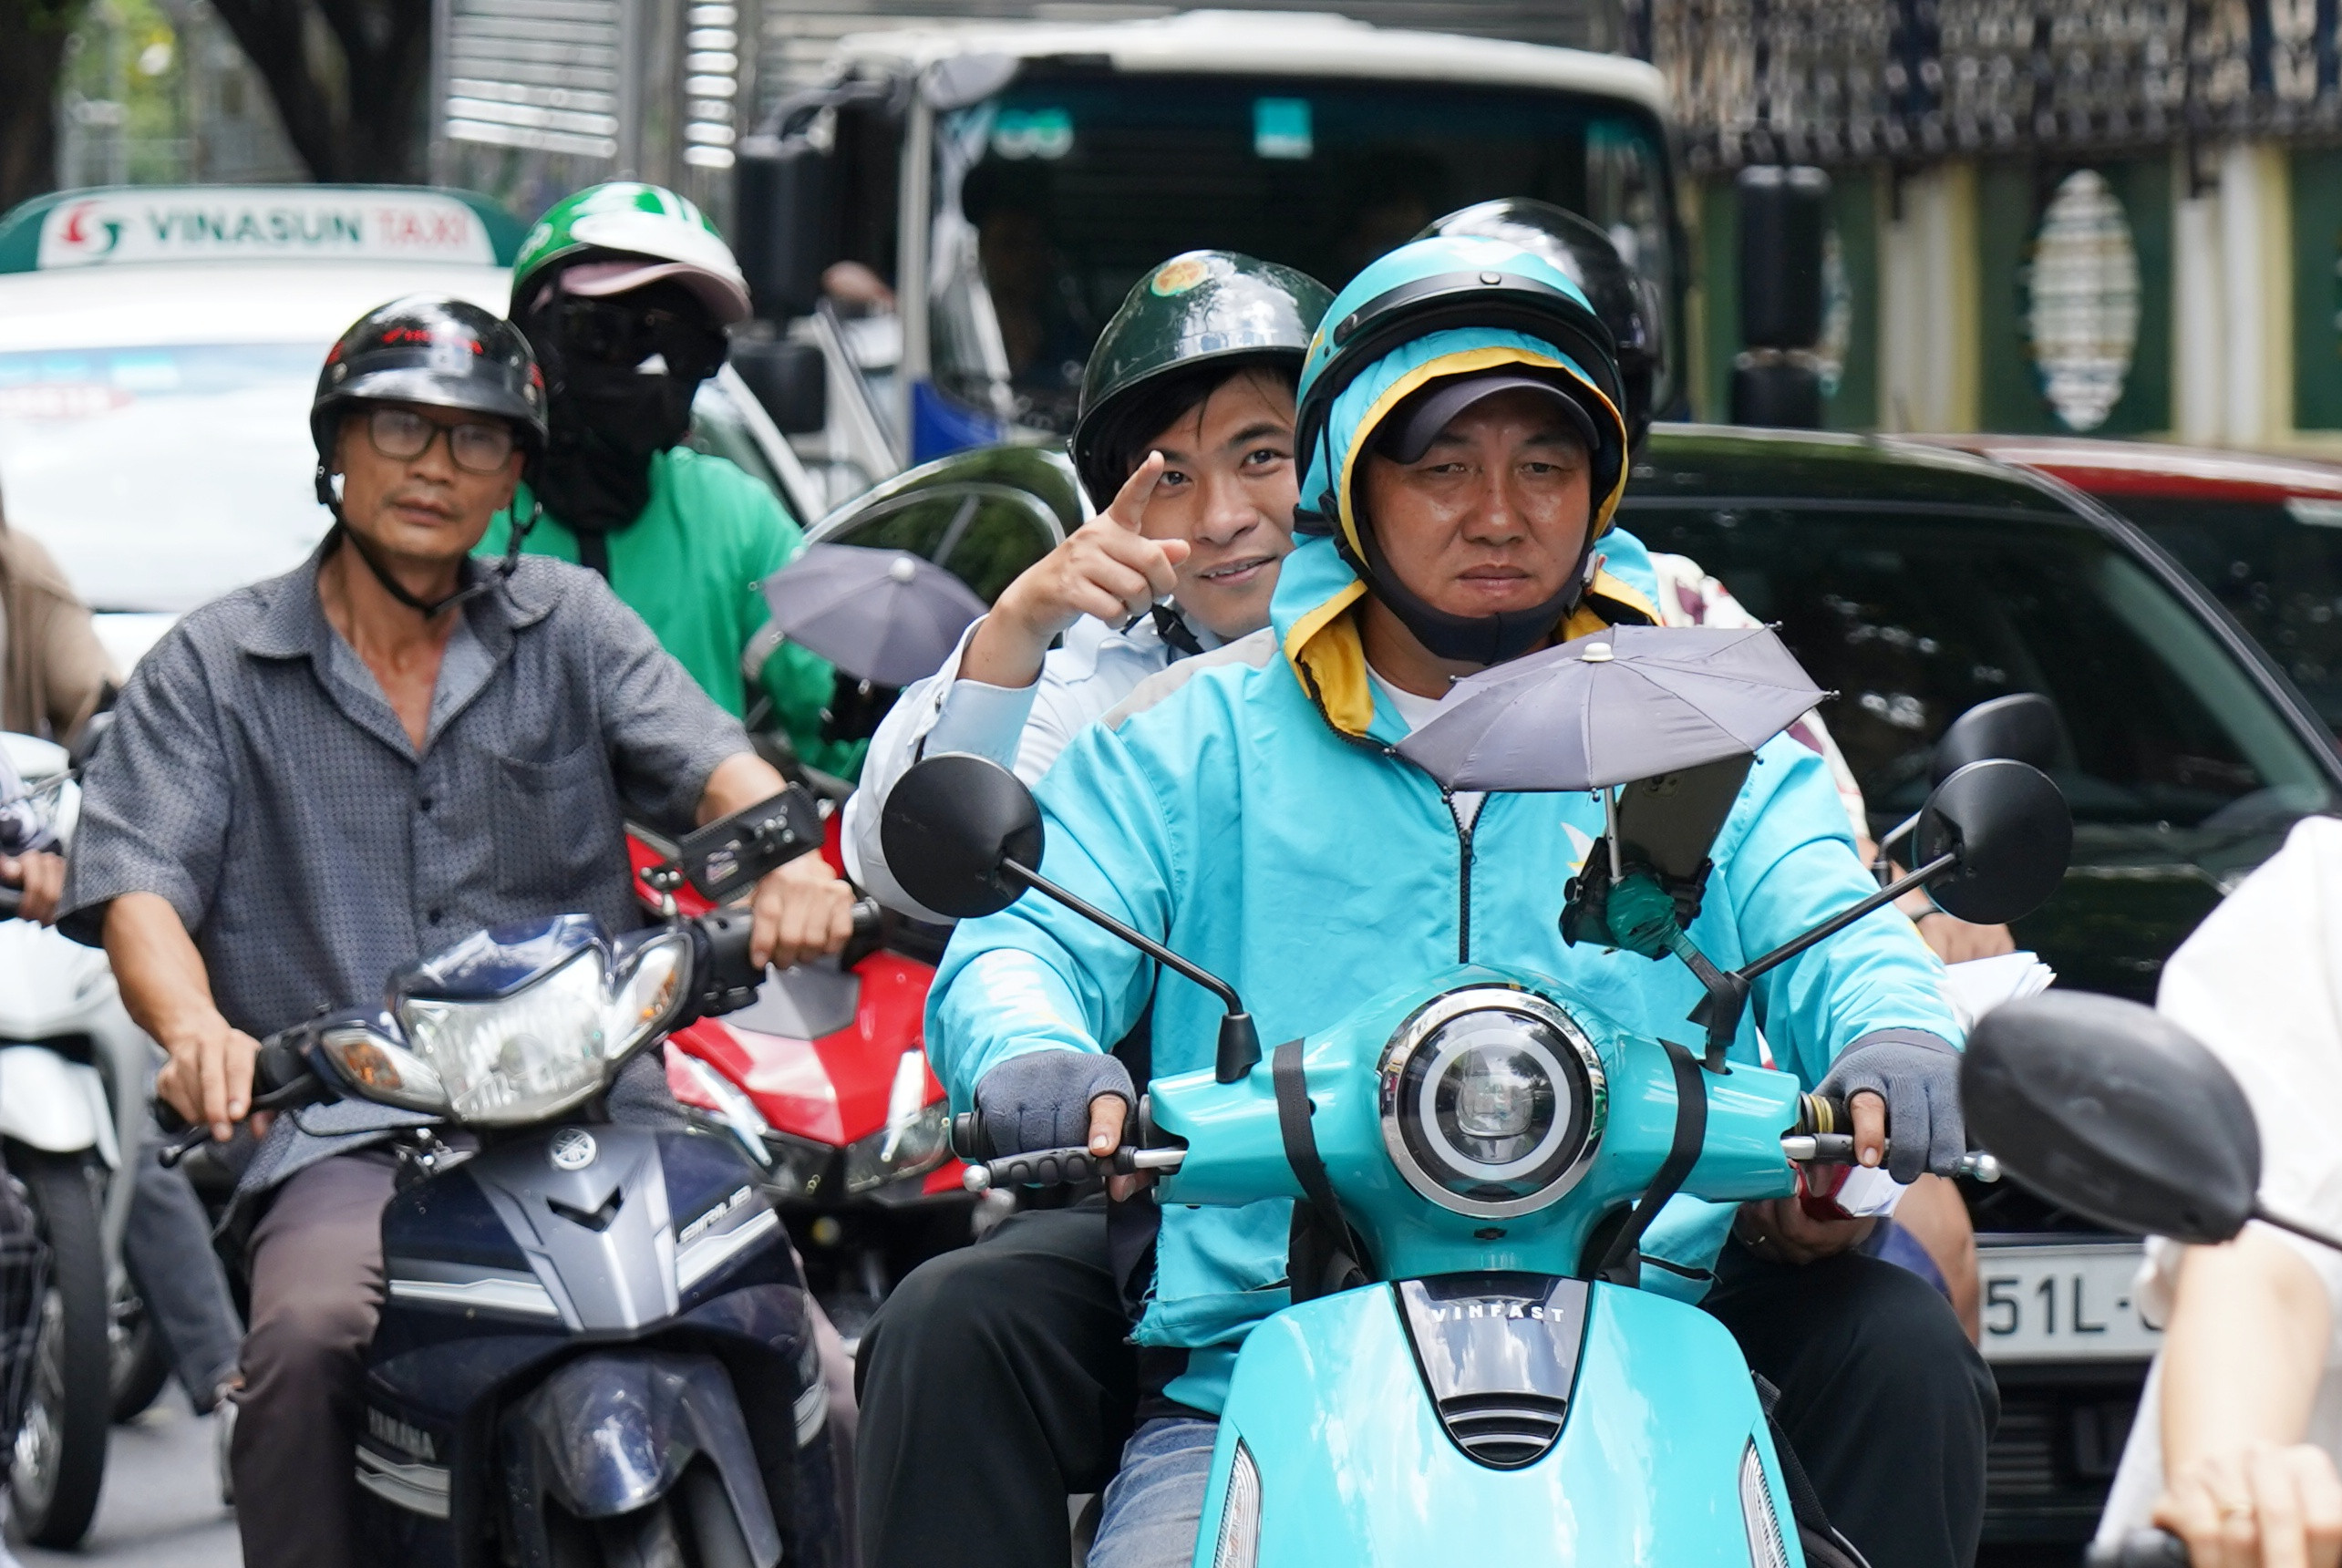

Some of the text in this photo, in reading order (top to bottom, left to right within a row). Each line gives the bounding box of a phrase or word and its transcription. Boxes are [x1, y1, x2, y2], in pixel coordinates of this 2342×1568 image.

[149, 206, 469, 247] VINASUN TAXI
[1431, 1304, 1564, 1323] VINFAST
[367, 1405, 437, 1462] YAMAHA
